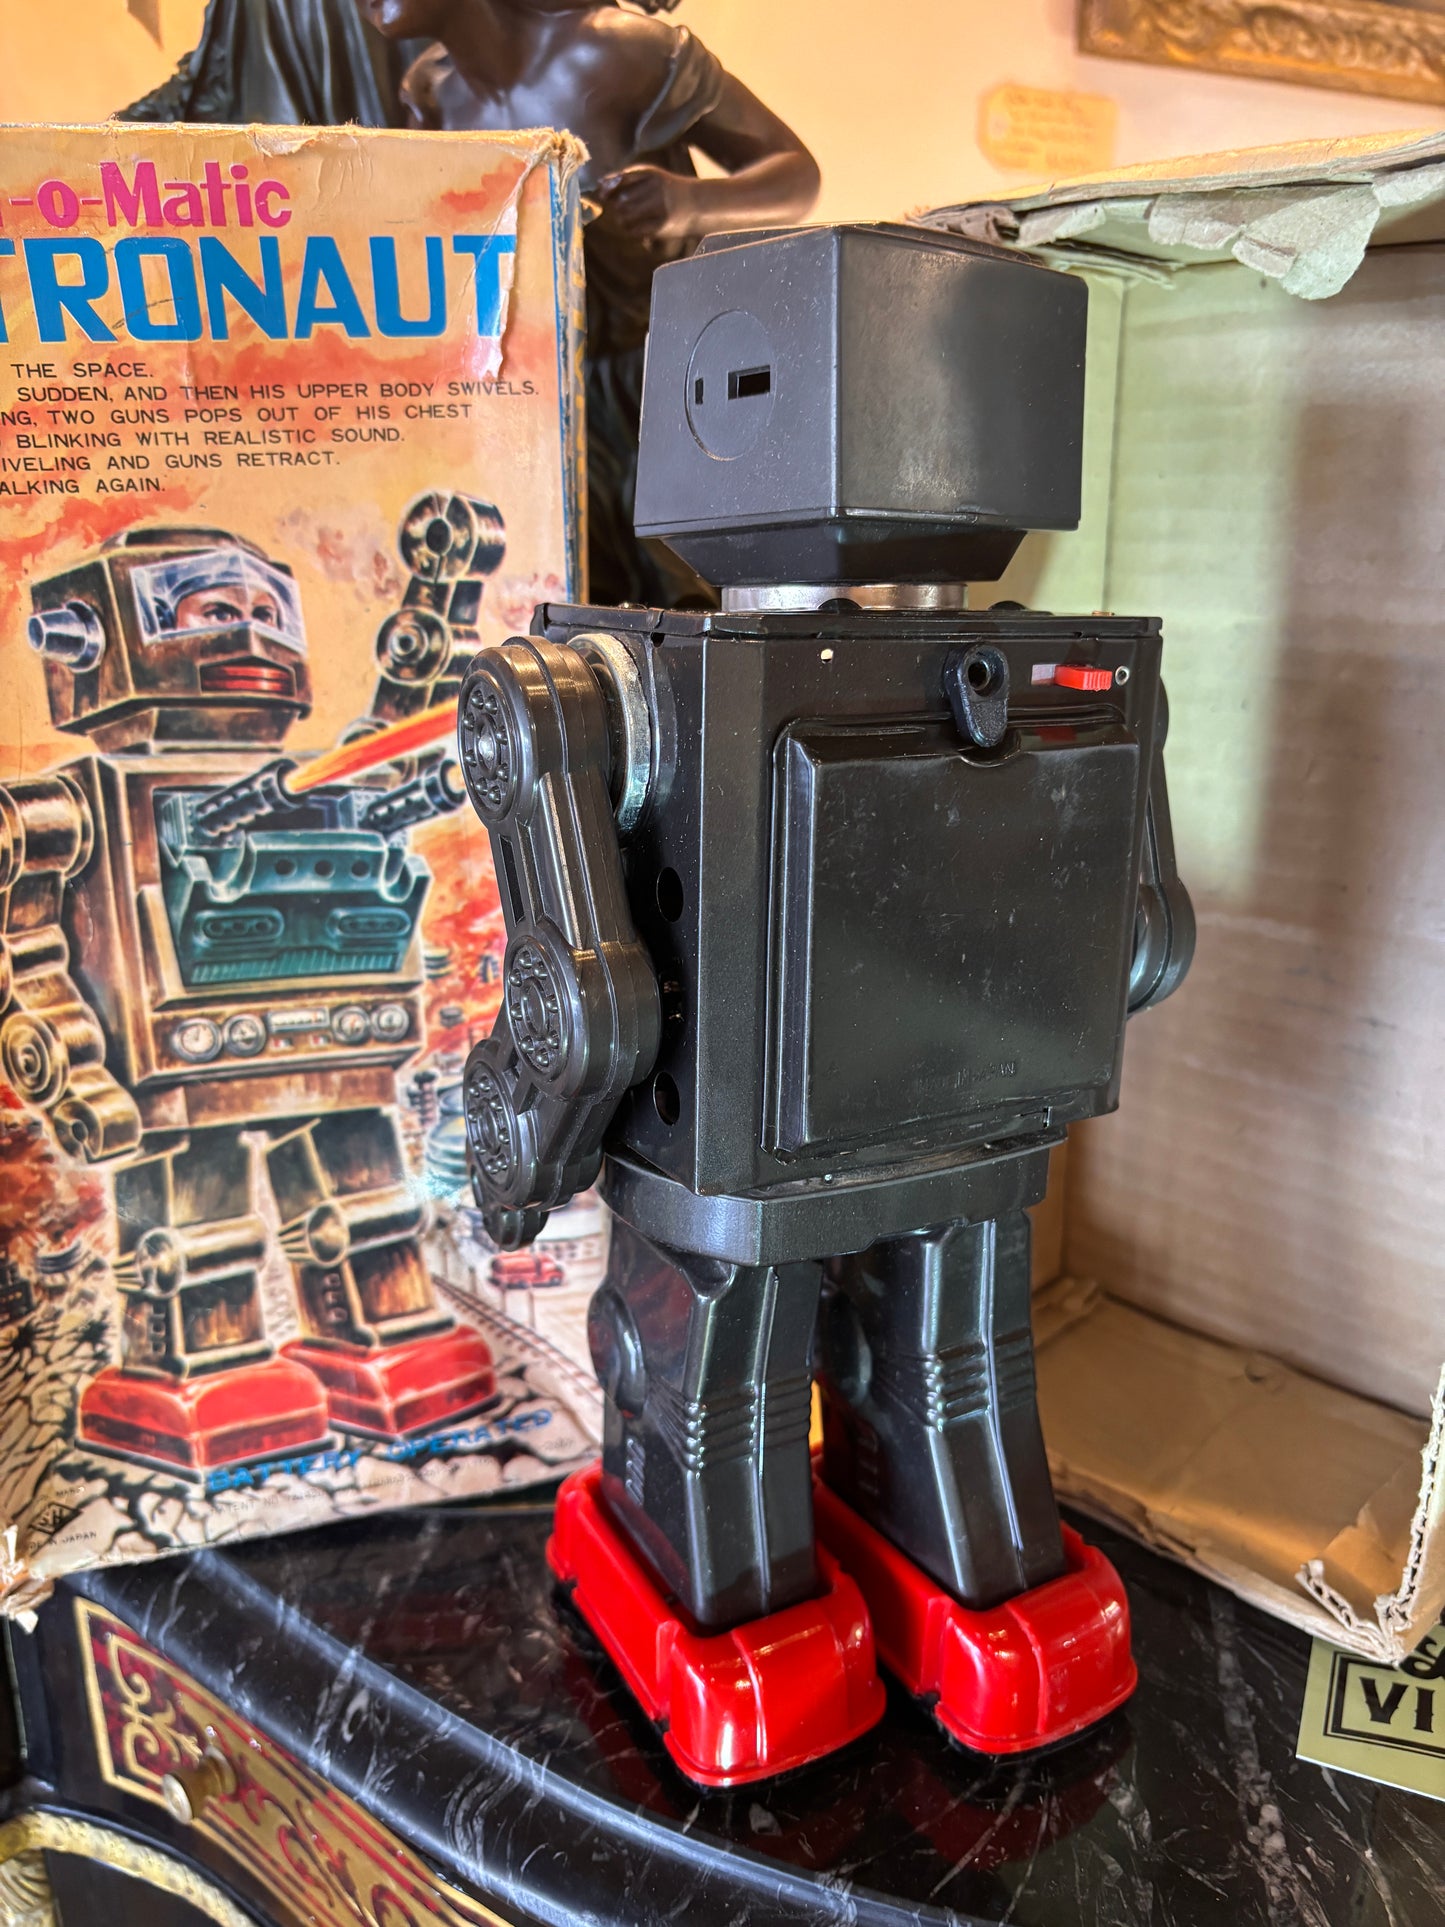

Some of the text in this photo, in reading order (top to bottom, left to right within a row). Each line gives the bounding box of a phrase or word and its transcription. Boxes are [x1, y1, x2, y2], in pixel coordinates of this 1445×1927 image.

[0, 161, 293, 229] -o-Matic
[0, 234, 517, 344] RONAUT
[10, 362, 154, 379] THE SPACE.
[17, 380, 540, 402] SUDDEN, AND THEN HIS UPPER BODY SWIVELS.
[1, 404, 473, 428] NG, TWO GUNS POPS OUT OF HIS CHEST
[16, 427, 406, 449] BLINKING WITH REALISTIC SOUND.
[2, 451, 341, 472] IVELING AND GUNS RETRACT.
[0, 478, 166, 496] ALKING AGAIN.
[207, 1447, 363, 1492] BATTERY
[385, 1408, 553, 1462] OPERATED
[62, 1530, 97, 1545] JAPAN
[1359, 1675, 1436, 1734] VI
